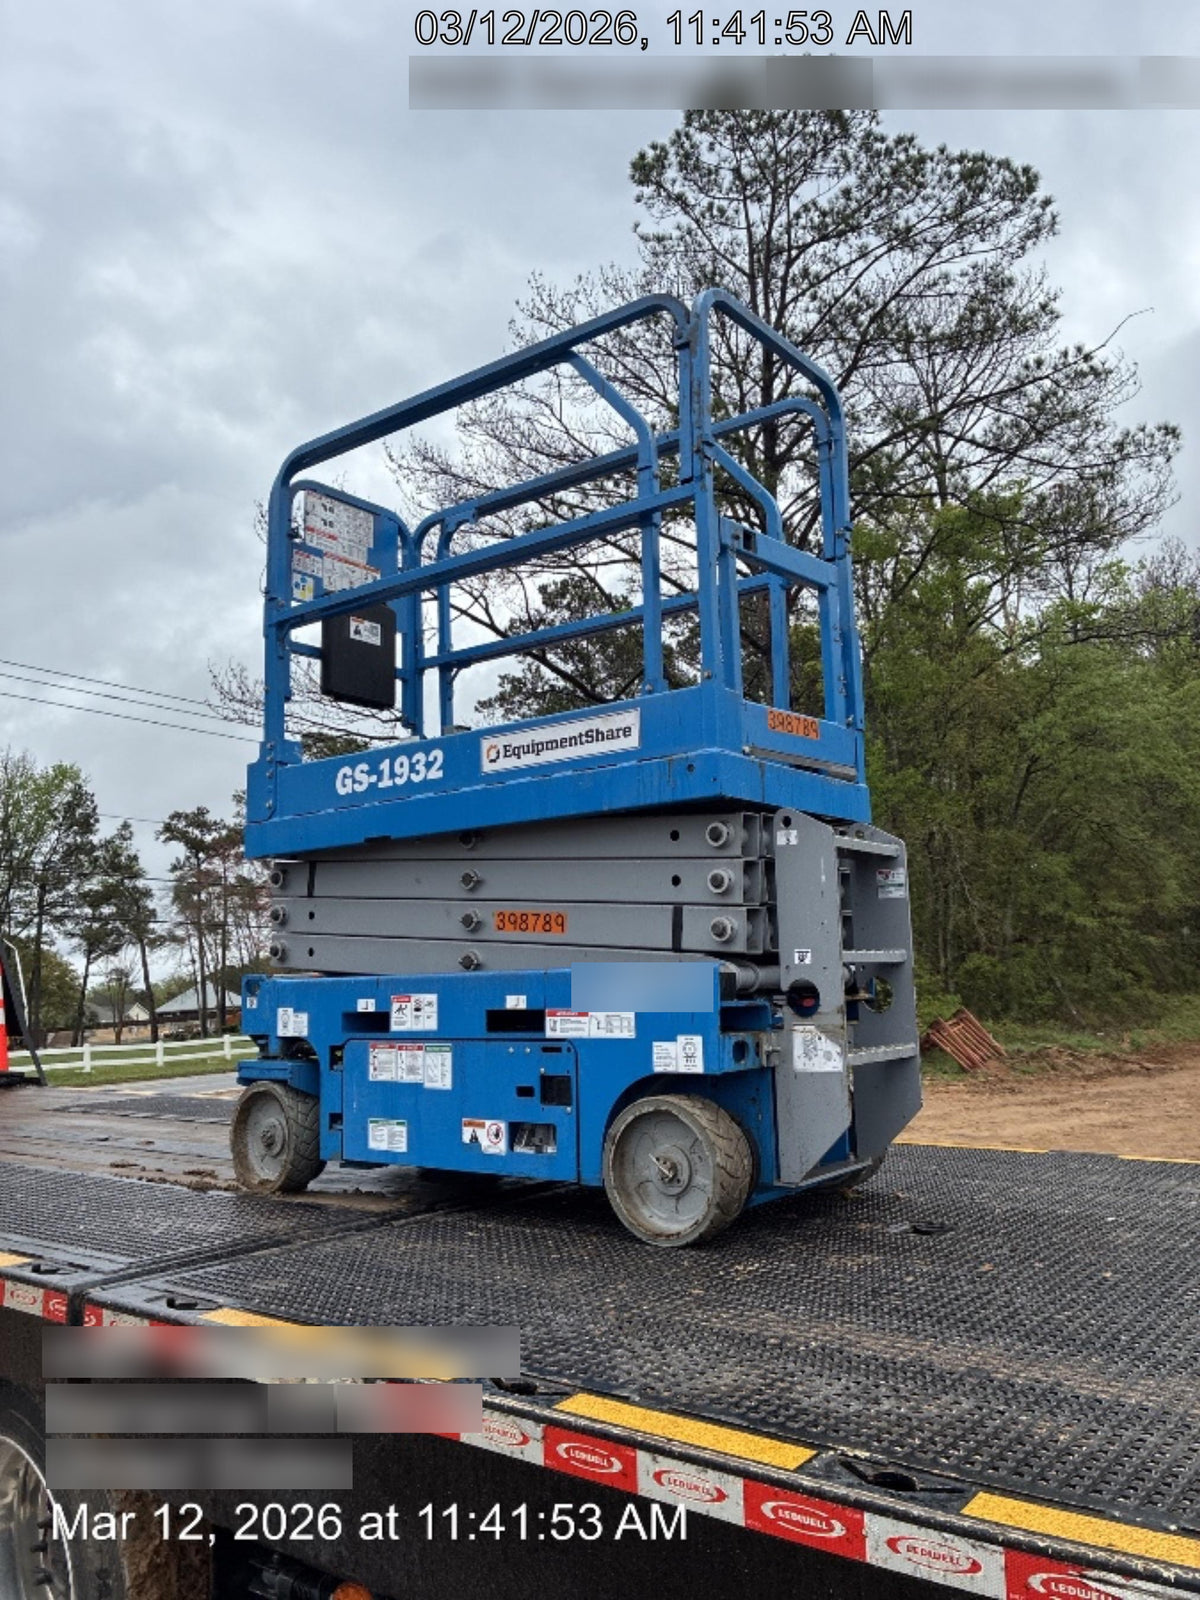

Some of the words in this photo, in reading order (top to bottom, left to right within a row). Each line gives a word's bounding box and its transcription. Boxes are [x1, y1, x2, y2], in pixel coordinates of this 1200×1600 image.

[768, 710, 819, 738] 398789
[503, 725, 632, 760] EquipmentShare
[335, 749, 444, 795] GS-1932
[497, 911, 565, 933] 398789
